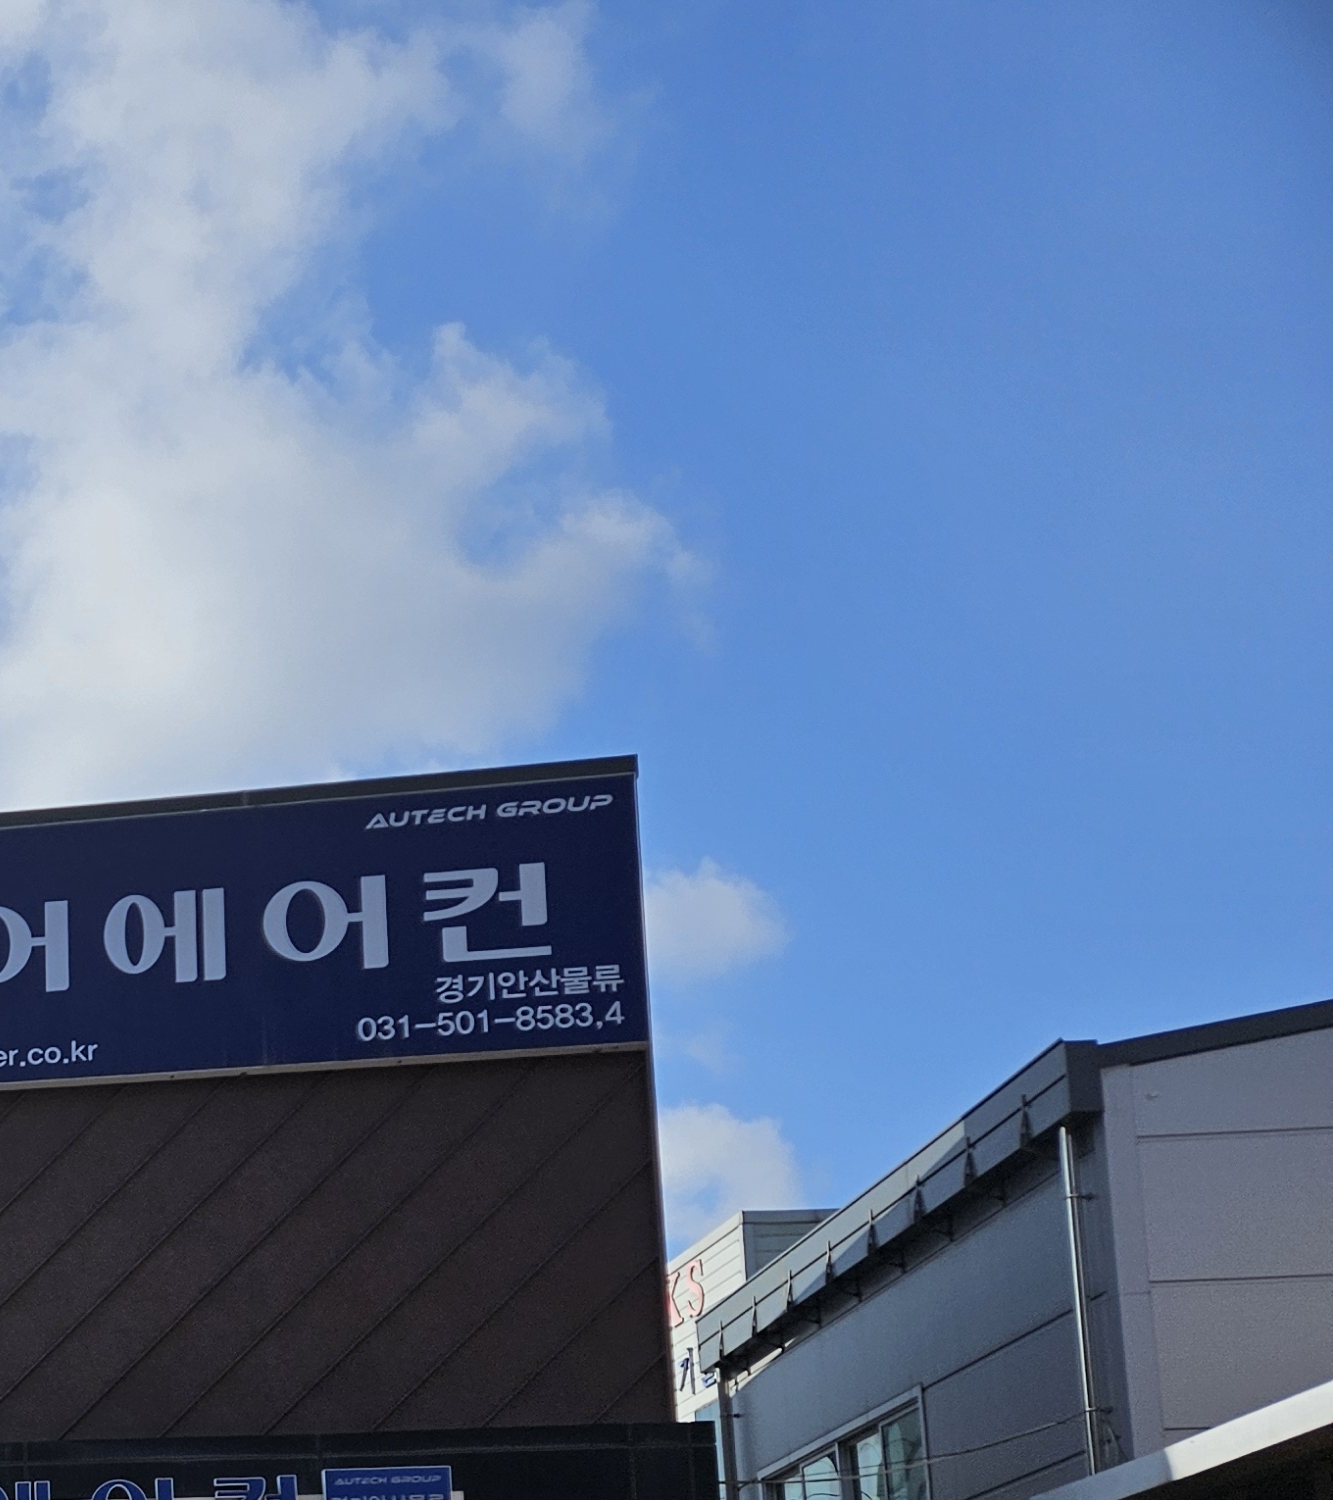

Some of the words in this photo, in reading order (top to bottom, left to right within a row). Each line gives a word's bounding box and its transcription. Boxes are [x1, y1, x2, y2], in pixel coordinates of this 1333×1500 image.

[366, 804, 487, 831] AUTECH
[496, 795, 612, 820] GROUP
[435, 965, 625, 1003] 경기안산물류
[356, 1001, 625, 1042] 031-501-8583,4
[335, 1477, 387, 1485] AUTECH
[391, 1475, 441, 1483] GROUP
